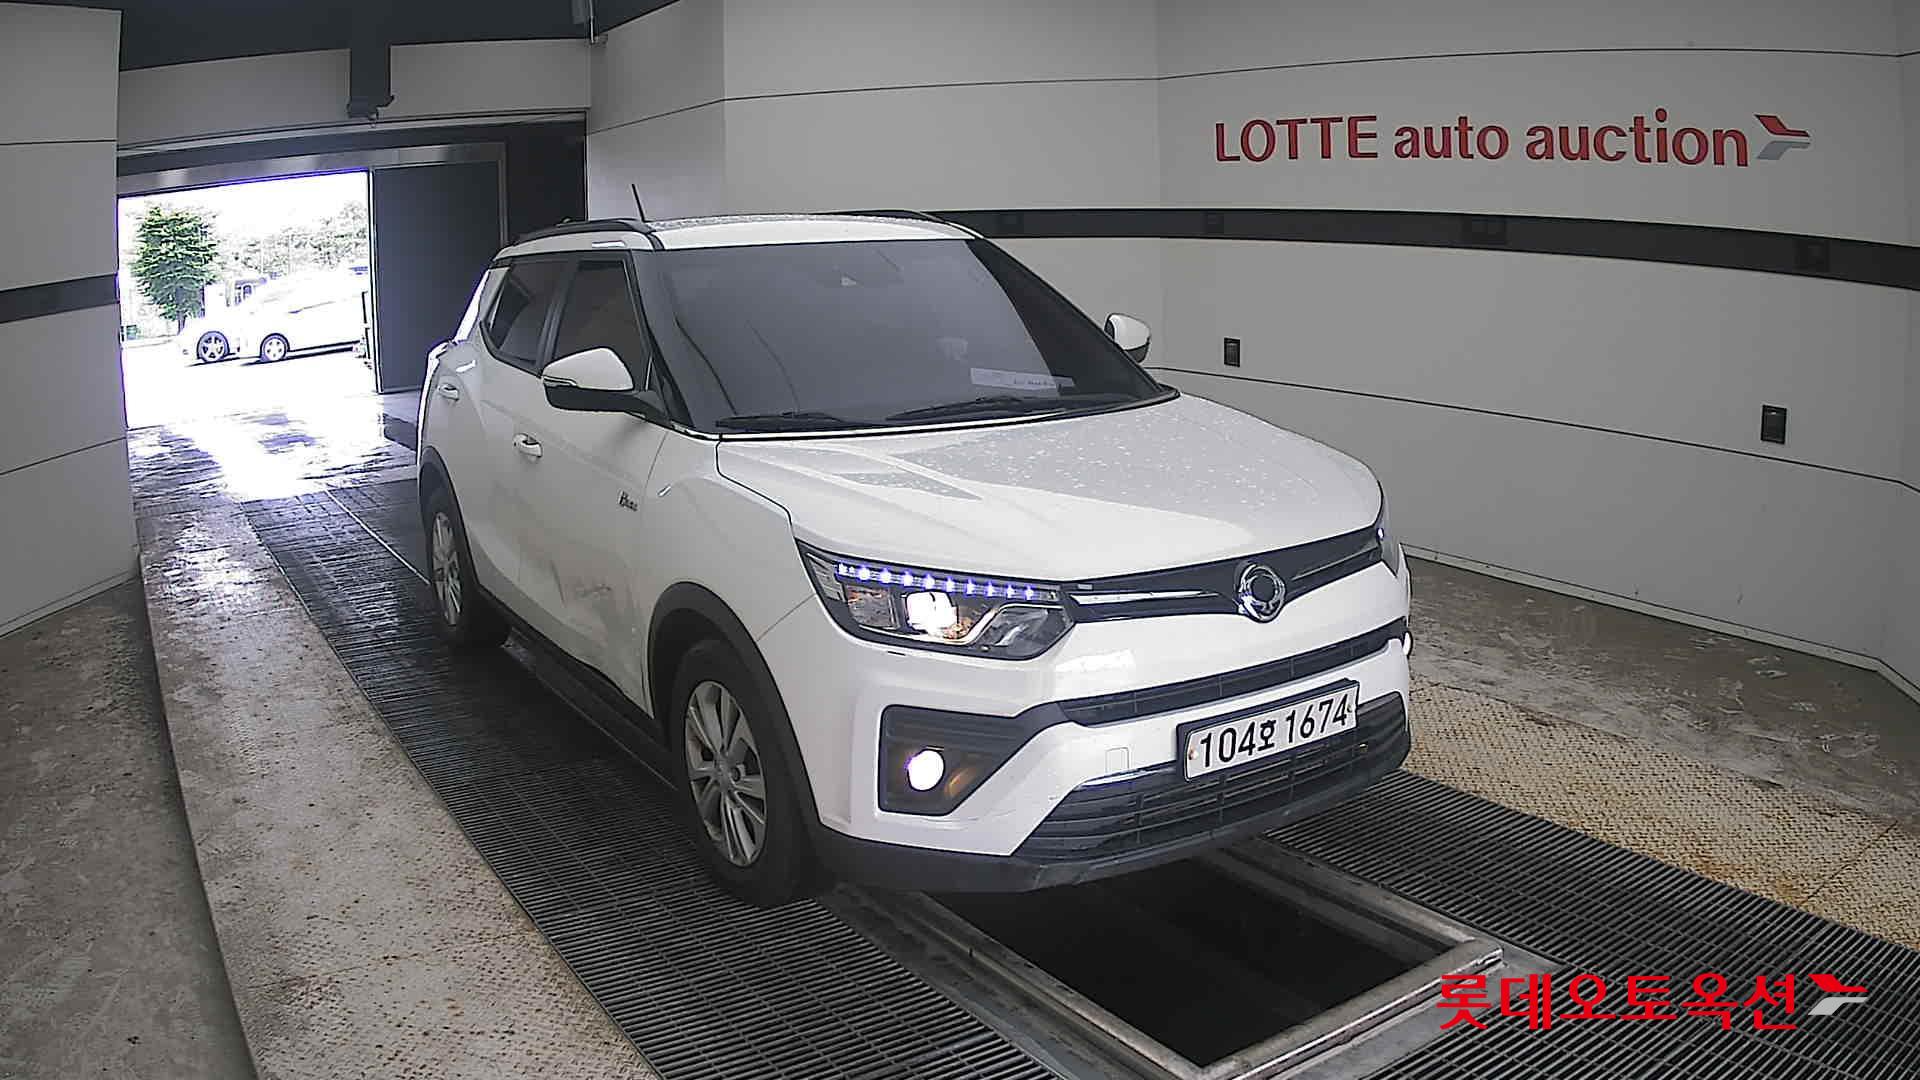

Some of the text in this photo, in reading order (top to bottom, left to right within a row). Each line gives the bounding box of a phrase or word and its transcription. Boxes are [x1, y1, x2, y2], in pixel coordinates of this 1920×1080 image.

[1215, 107, 1749, 167] LOTTE auto auction
[1200, 693, 1349, 768] 104호 1674
